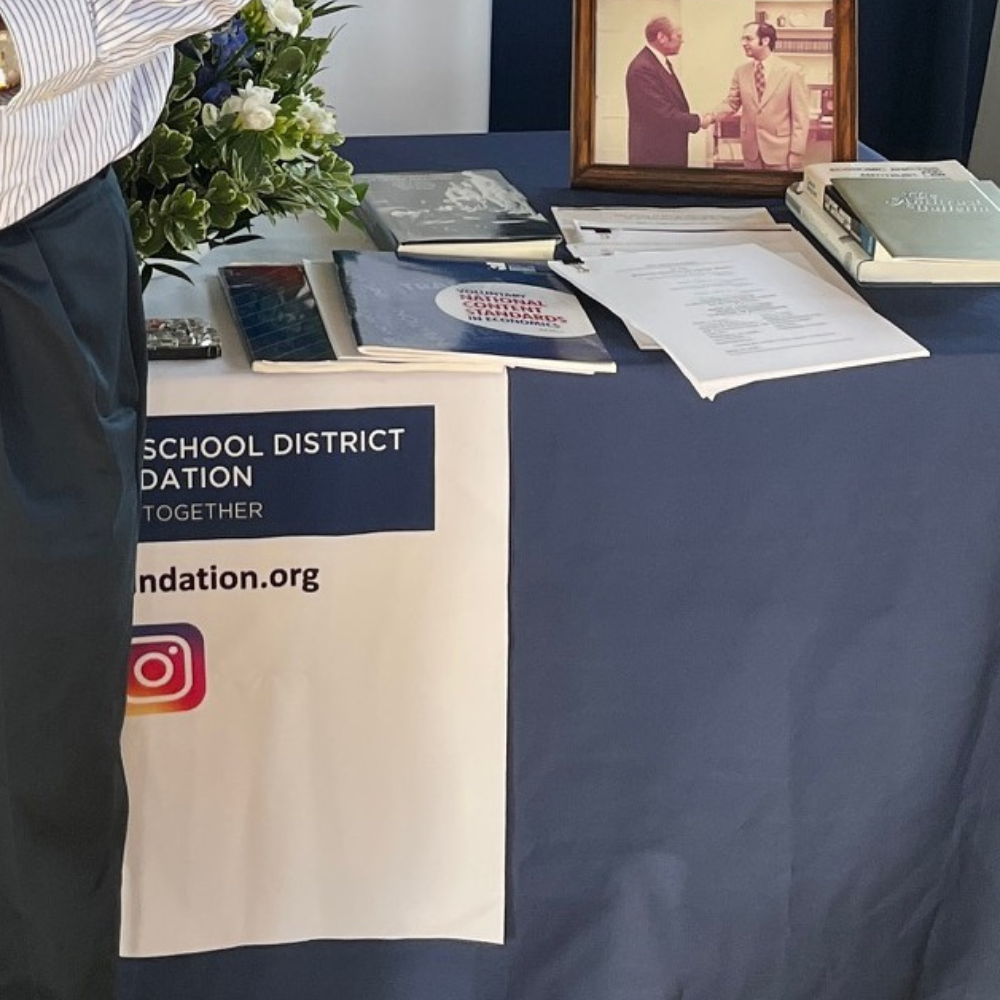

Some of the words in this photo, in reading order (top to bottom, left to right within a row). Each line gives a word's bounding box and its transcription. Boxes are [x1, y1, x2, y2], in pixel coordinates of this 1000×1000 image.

[460, 294, 548, 308] NATIONAL
[463, 301, 542, 314] CONTENT
[465, 308, 568, 324] STANDARDS
[142, 435, 264, 460] SCHOOL
[273, 428, 405, 455] DISTRICT
[141, 465, 253, 490] DATION
[143, 502, 264, 522] TOGETHER
[138, 565, 320, 593] ndation.org
